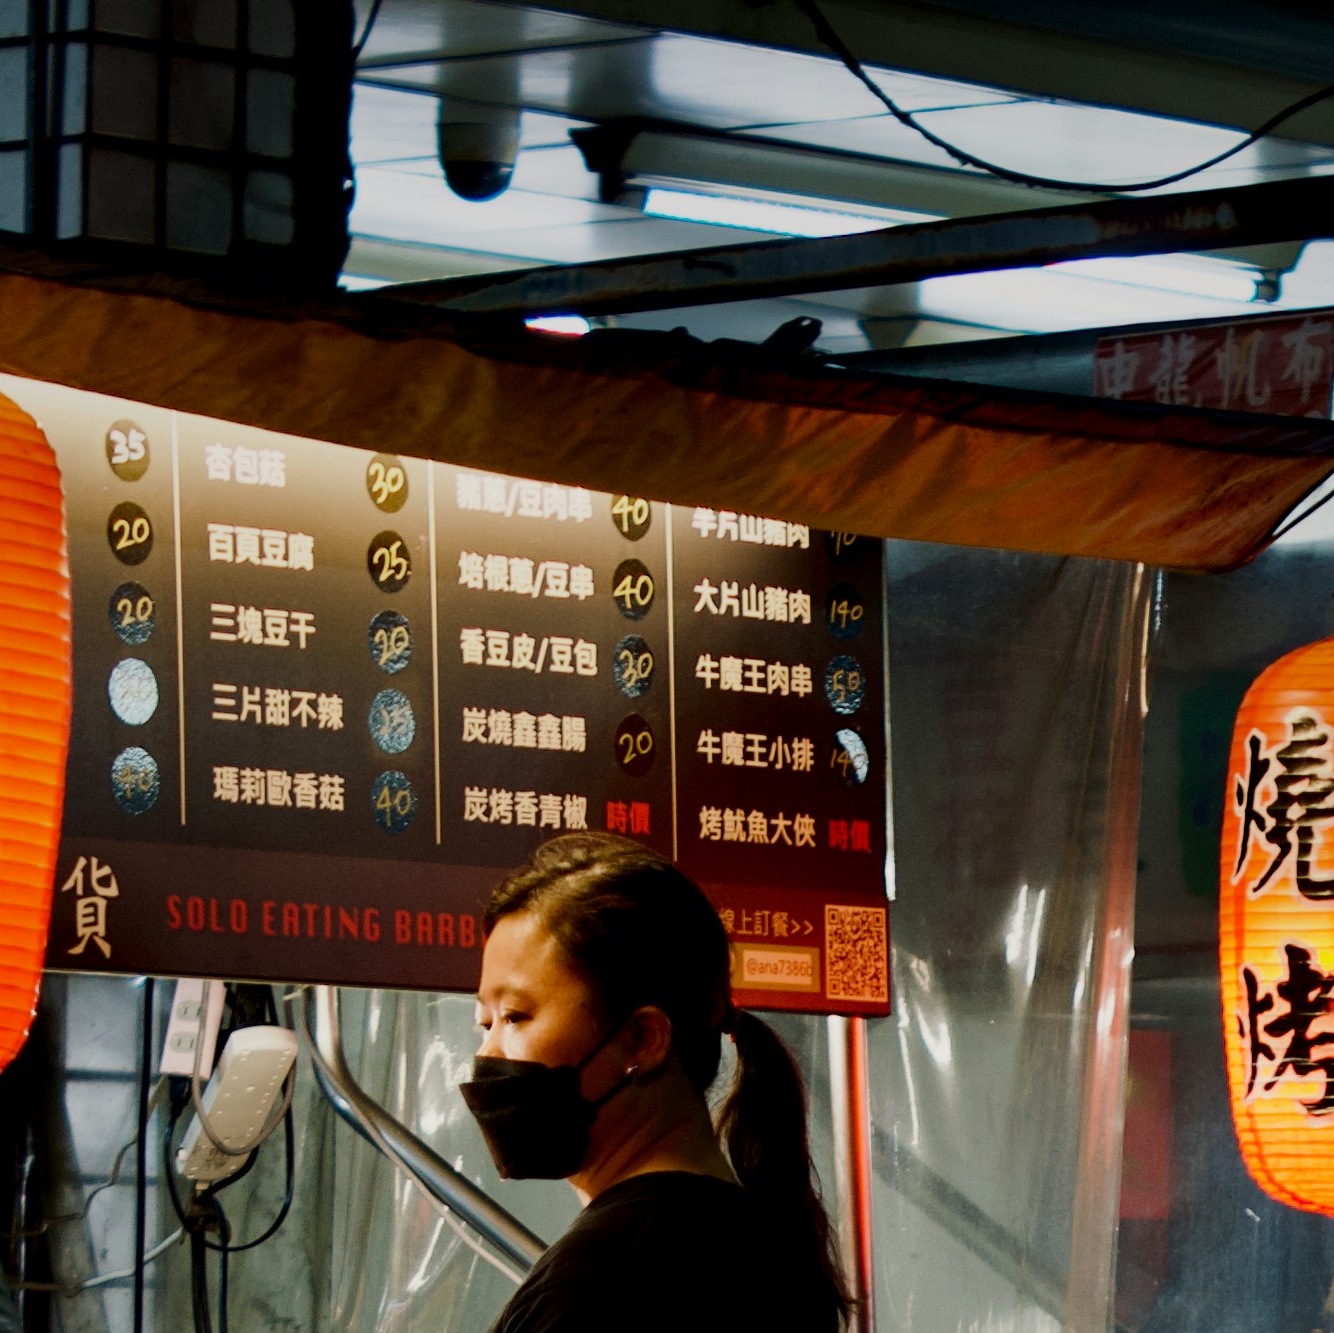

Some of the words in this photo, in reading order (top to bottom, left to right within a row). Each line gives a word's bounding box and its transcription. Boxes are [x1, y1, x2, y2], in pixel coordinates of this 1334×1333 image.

[109, 428, 145, 463] 35
[369, 462, 404, 504] 30
[113, 517, 149, 549] 20
[612, 494, 648, 532] 40
[373, 541, 407, 582] 25
[117, 597, 152, 626] 20
[613, 574, 653, 609] 40
[210, 602, 316, 649] 三塊豆干
[830, 600, 863, 628] 140
[374, 626, 409, 666] 20
[460, 628, 598, 677] 香豆皮/豆包
[620, 649, 653, 688] 30
[695, 653, 813, 698] 牛魔王肉串
[832, 670, 860, 702] 50
[212, 683, 344, 731] 三片甜不辣
[619, 731, 653, 765] 20
[696, 728, 815, 772] 牛魔王小排
[213, 765, 345, 811] 瑪莉歐香菇
[375, 785, 411, 827] 40
[463, 787, 588, 830] 炭烤香青椒
[62, 855, 119, 959] 貨
[167, 894, 248, 933] SOLO
[262, 901, 380, 942] EATING
[395, 910, 485, 949] BARB
